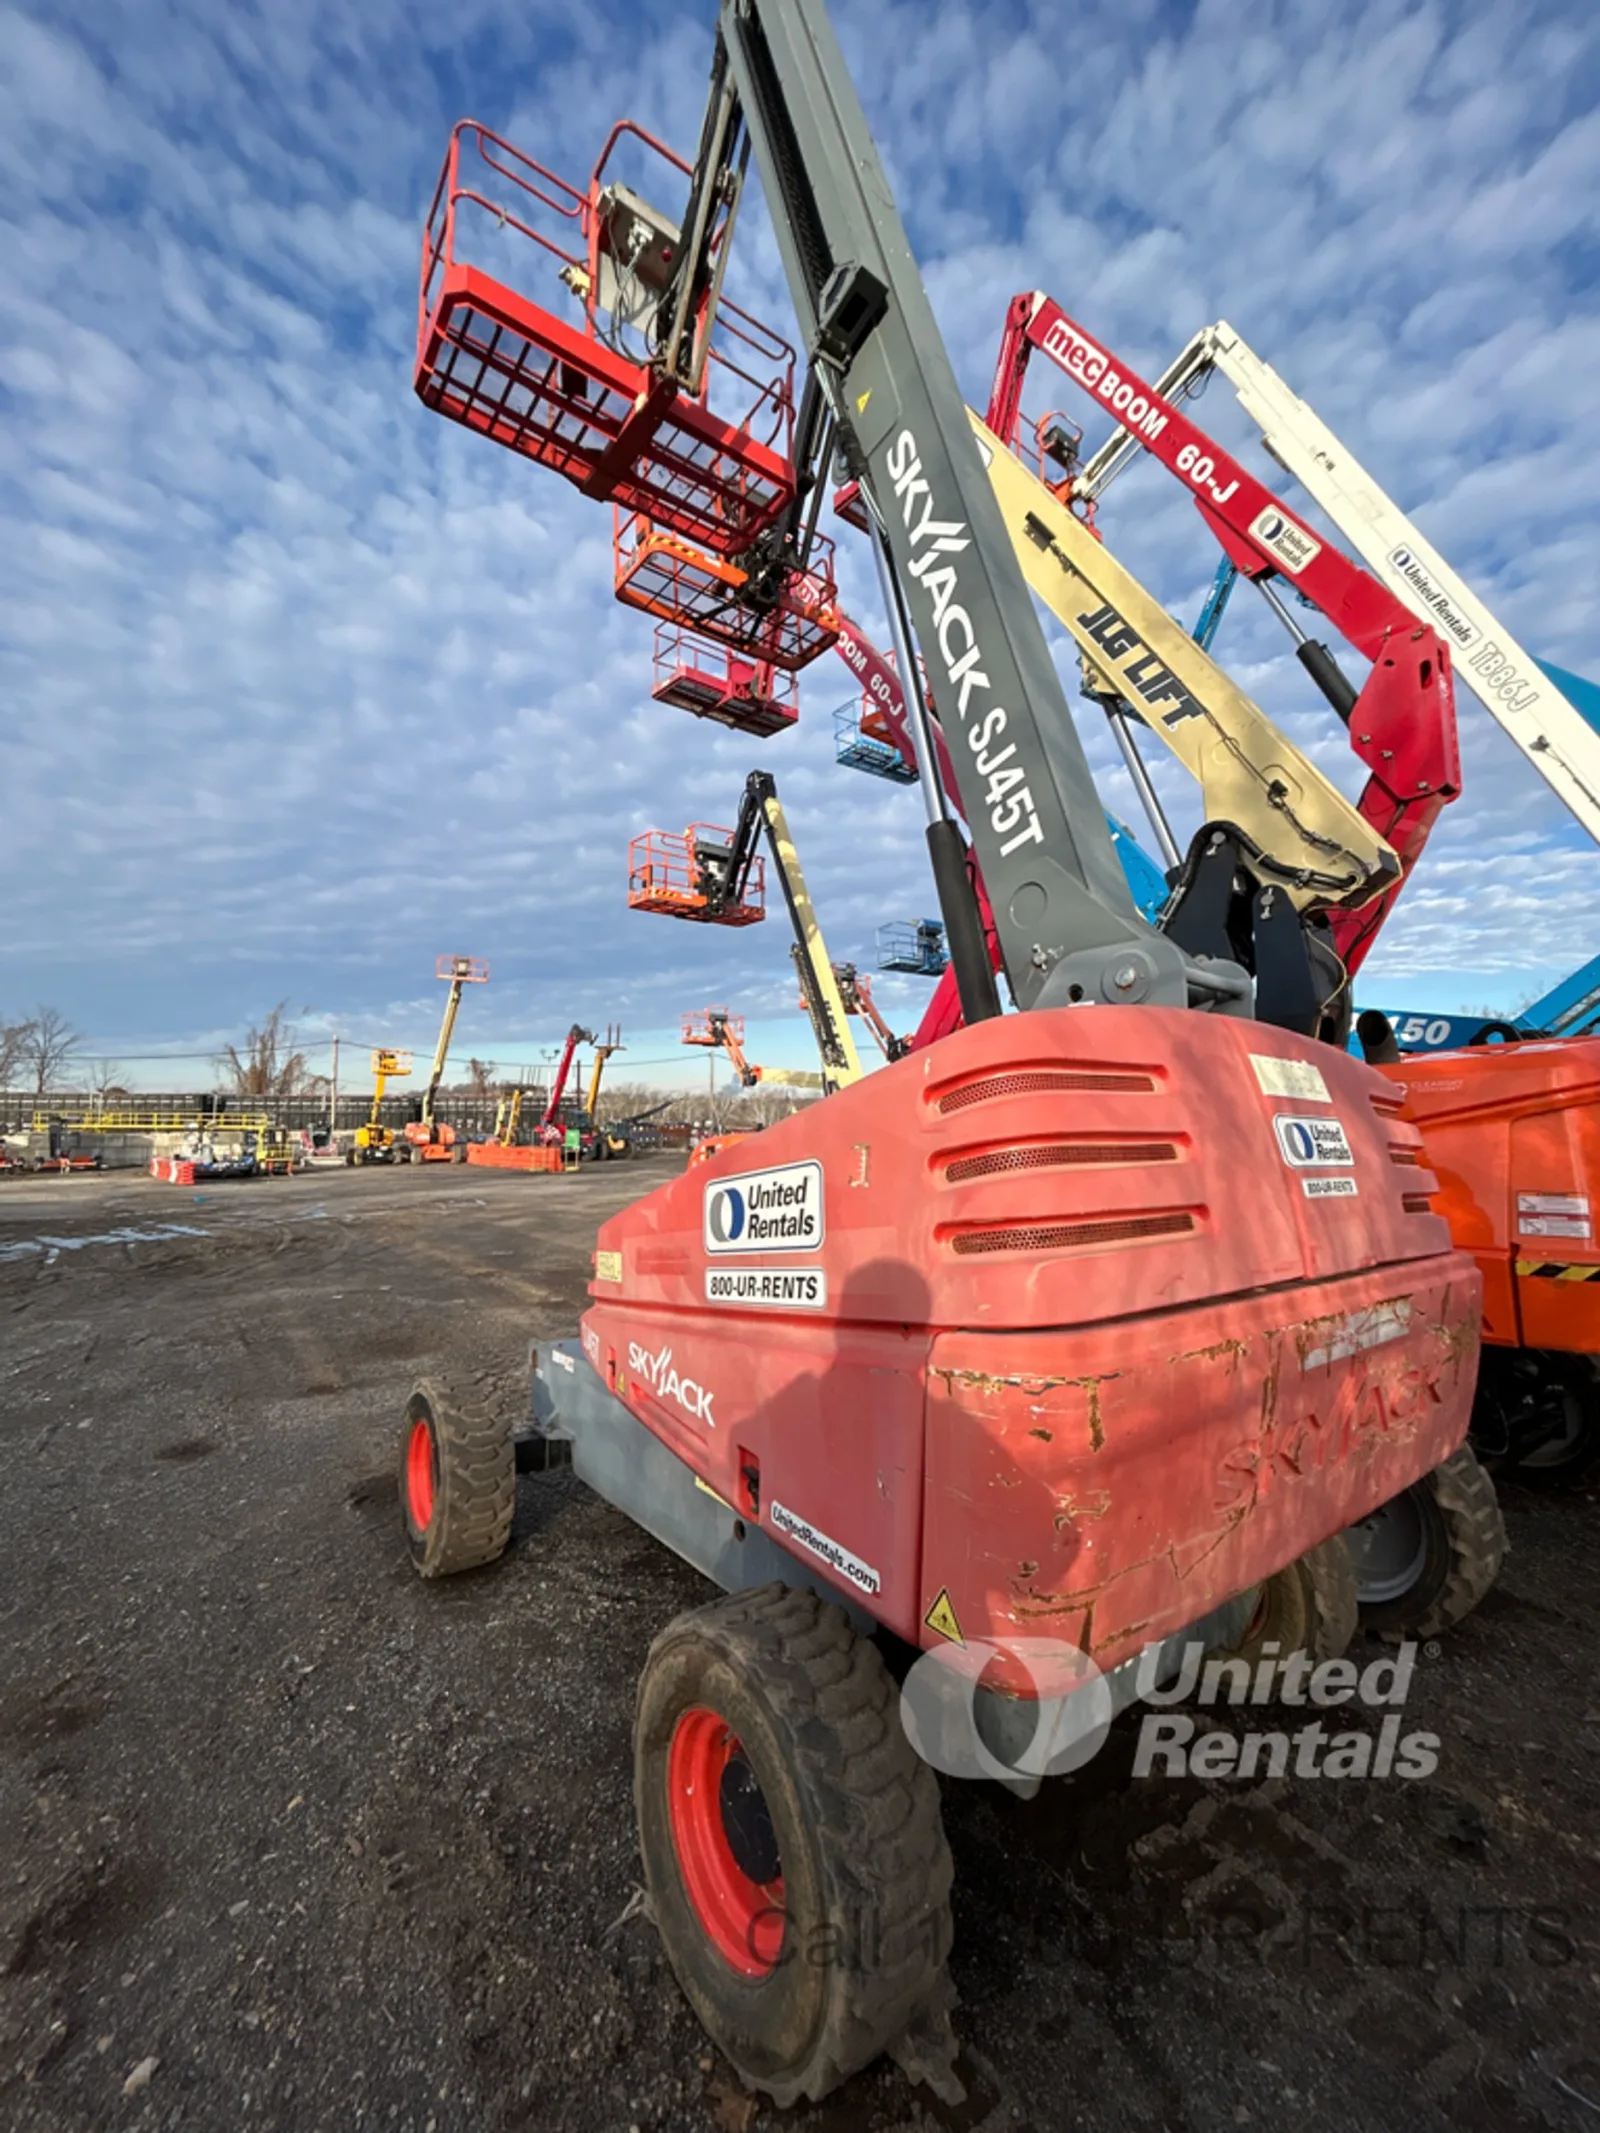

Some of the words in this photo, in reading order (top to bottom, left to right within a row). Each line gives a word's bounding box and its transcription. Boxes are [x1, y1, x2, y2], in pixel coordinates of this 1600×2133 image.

[1097, 371, 1169, 440] BOOM
[1175, 444, 1241, 503] 60-J
[1272, 537, 1303, 567] Rentals
[1281, 527, 1314, 556] United
[1404, 563, 1441, 602] United
[1432, 598, 1471, 642] Rentals
[886, 429, 991, 721] SKYJACK
[968, 707, 1045, 857] SJ45T
[1076, 604, 1142, 660] JLG
[1122, 652, 1205, 727] LIFT
[836, 629, 867, 672] OOM
[870, 673, 904, 716] 60-J
[1309, 1123, 1342, 1142] United
[1315, 1143, 1351, 1160] Rentals
[748, 1175, 808, 1210] United
[748, 1208, 815, 1240] Rentals
[710, 1275, 818, 1300] 800-UR-RENTS
[628, 1341, 716, 1427] SKYJACK
[773, 1505, 878, 1592] UnitedRentals.com
